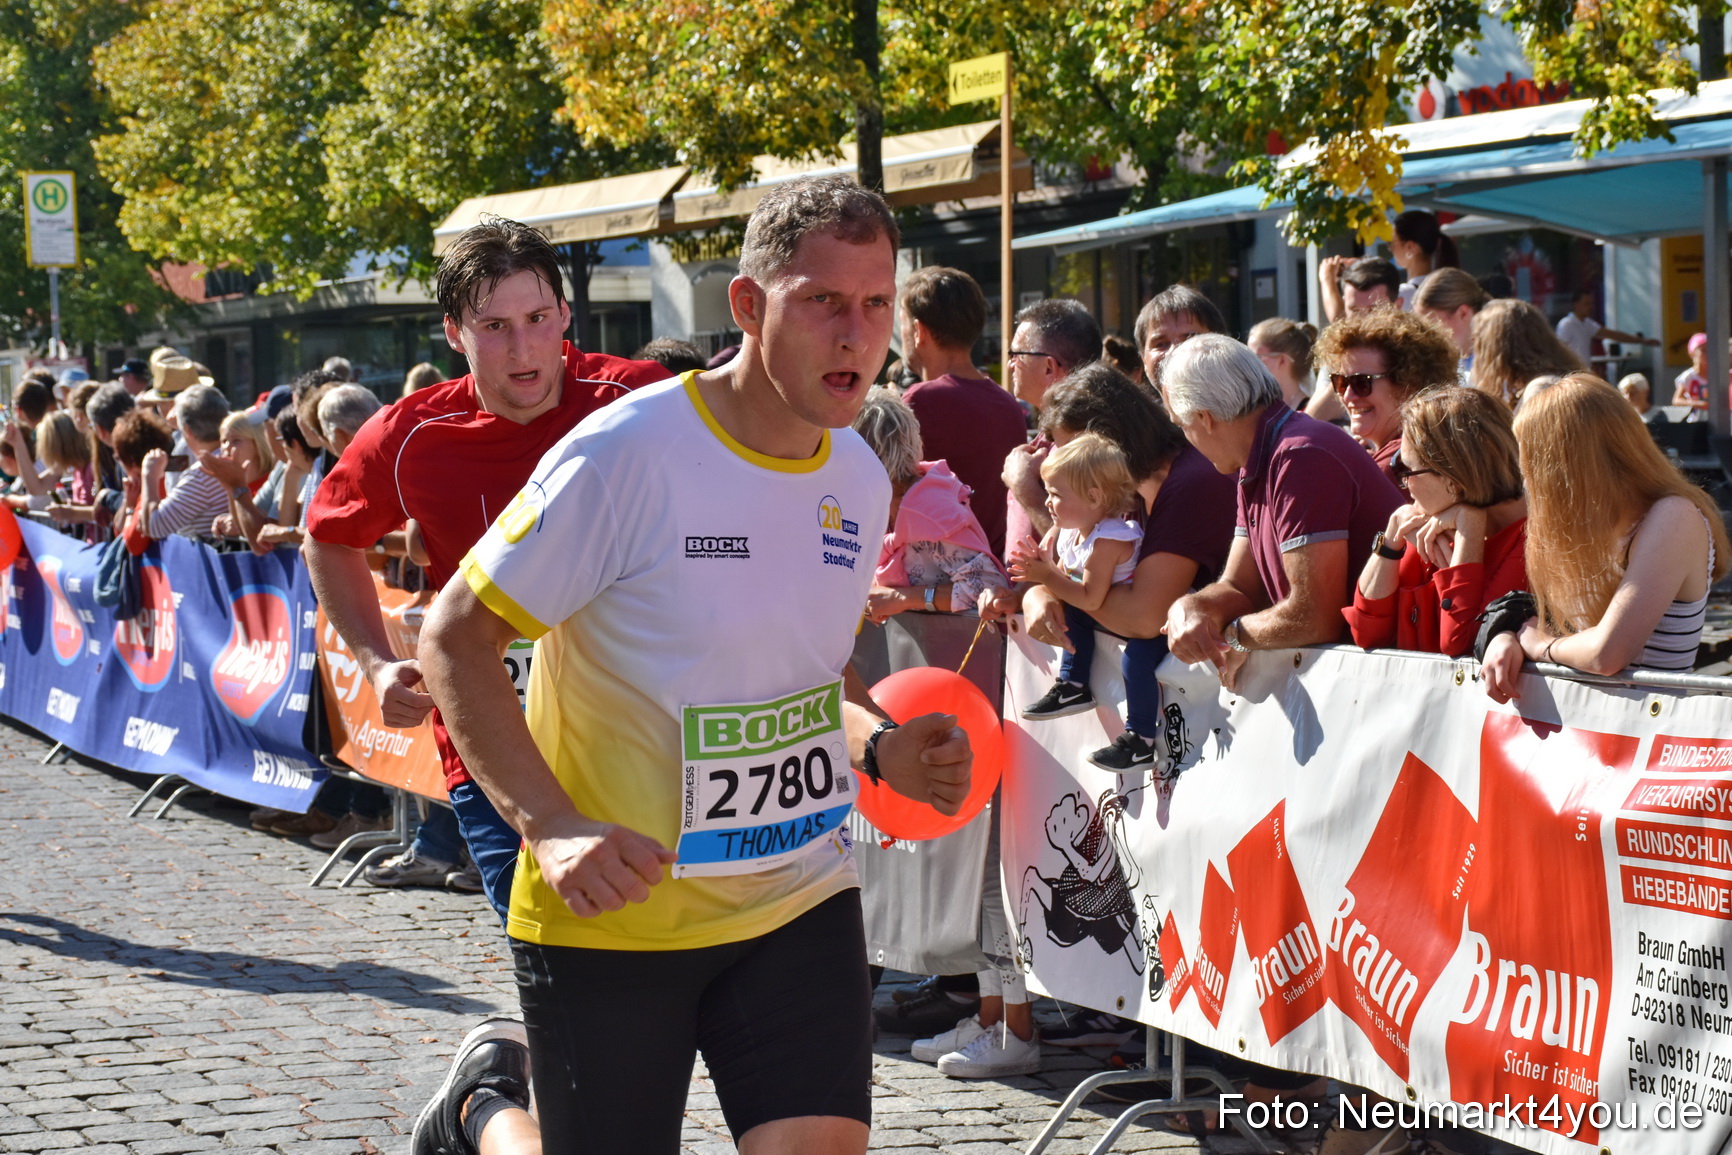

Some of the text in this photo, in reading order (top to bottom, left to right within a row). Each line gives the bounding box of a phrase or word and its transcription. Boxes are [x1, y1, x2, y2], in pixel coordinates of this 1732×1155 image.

[960, 69, 1002, 90] Toiletten
[821, 504, 841, 530] 20
[686, 537, 749, 553] BOCK
[823, 551, 856, 572] Stadtlauf
[355, 719, 414, 759] Agentur
[701, 690, 829, 751] BOCK
[705, 746, 833, 821] 2780
[717, 812, 825, 860] THOMAS
[1575, 808, 1590, 842] Seit
[1627, 828, 1732, 866] RUNDSCHLIN
[1451, 843, 1476, 900] Seit 1929
[1632, 875, 1732, 914] HEBEBÄNDE
[1251, 922, 1319, 1009] Braun
[1326, 886, 1419, 1028] Braun
[1638, 931, 1726, 971] Braun GmbH
[1282, 985, 1306, 1005] Sicher
[1305, 976, 1314, 989] ist
[1450, 930, 1600, 1056] Braun
[1636, 962, 1729, 1009] Am Grünberg
[1354, 985, 1374, 1020] Sicher
[1375, 1012, 1385, 1031] ist
[1631, 993, 1732, 1036] D-92318 Neum
[1503, 1049, 1599, 1097] Sicher ist sicher
[1627, 1037, 1732, 1084] Tel. 09181 / 230
[1628, 1068, 1656, 1095] Fax
